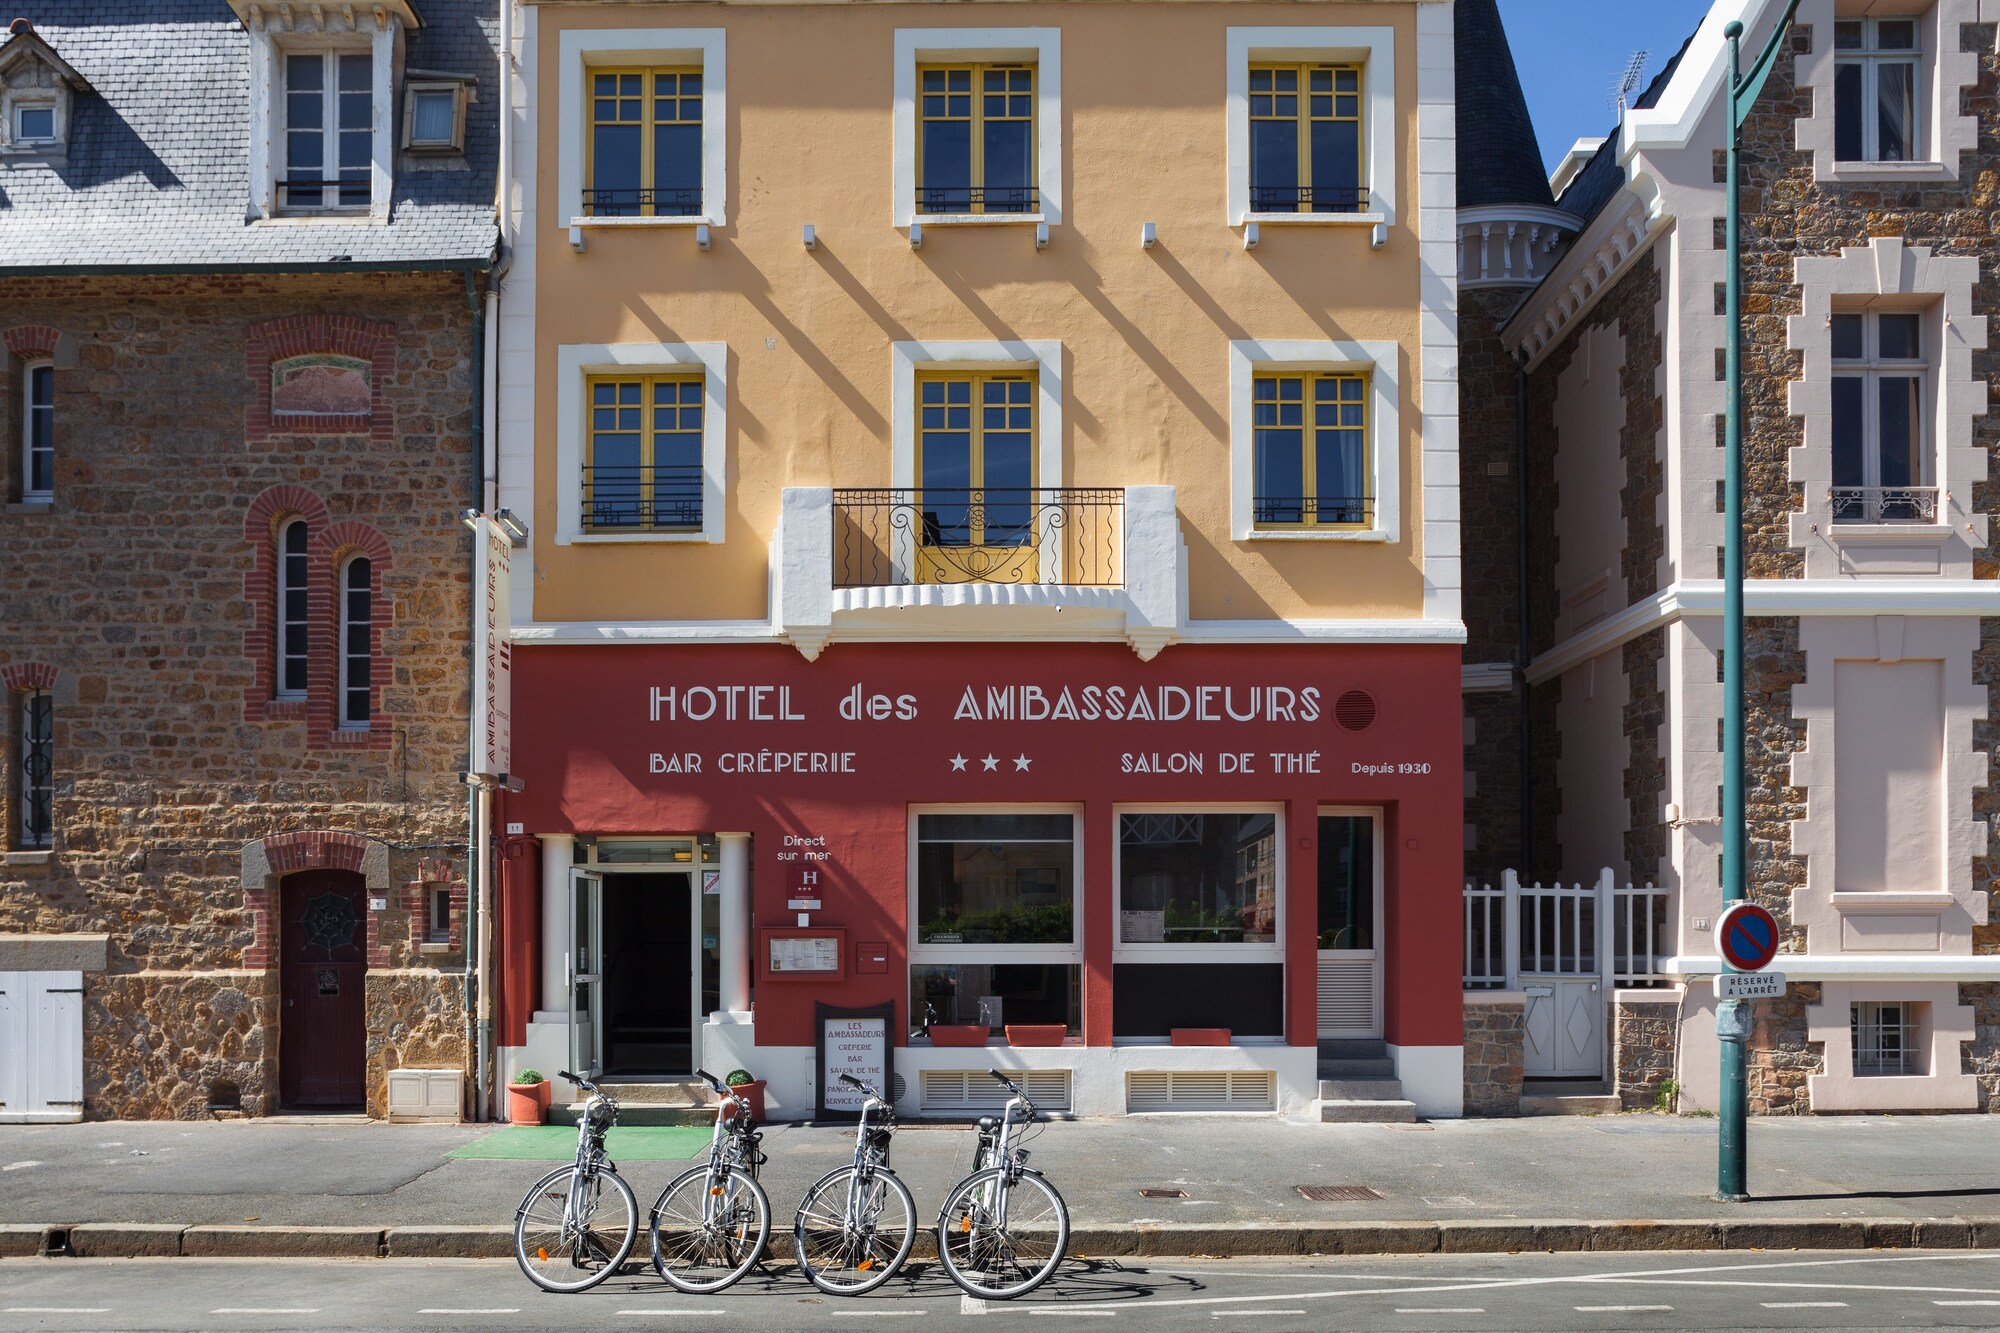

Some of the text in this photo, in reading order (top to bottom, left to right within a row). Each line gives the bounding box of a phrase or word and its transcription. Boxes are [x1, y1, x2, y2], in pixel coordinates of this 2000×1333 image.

[488, 530, 511, 562] HOTEL
[487, 558, 496, 765] AMBASSADEURS
[649, 682, 1321, 722] HOTEL des AMBASSADEURS
[649, 748, 856, 774] BAR CRÊPERIE
[1120, 750, 1321, 775] SALON DE THÉ
[1351, 762, 1432, 777] Depuis 1930
[783, 834, 826, 847] Direct
[777, 851, 832, 861] sur mer
[803, 871, 818, 885] H
[1730, 975, 1775, 986] RÉSERVÉ
[1728, 985, 1778, 996] A L'ARRÊT
[848, 1022, 862, 1030] LES
[828, 1030, 885, 1039] AMBASSADEURS
[847, 1055, 863, 1063] BAR
[830, 1066, 854, 1074] SALON
[838, 1078, 873, 1086] TESSE
